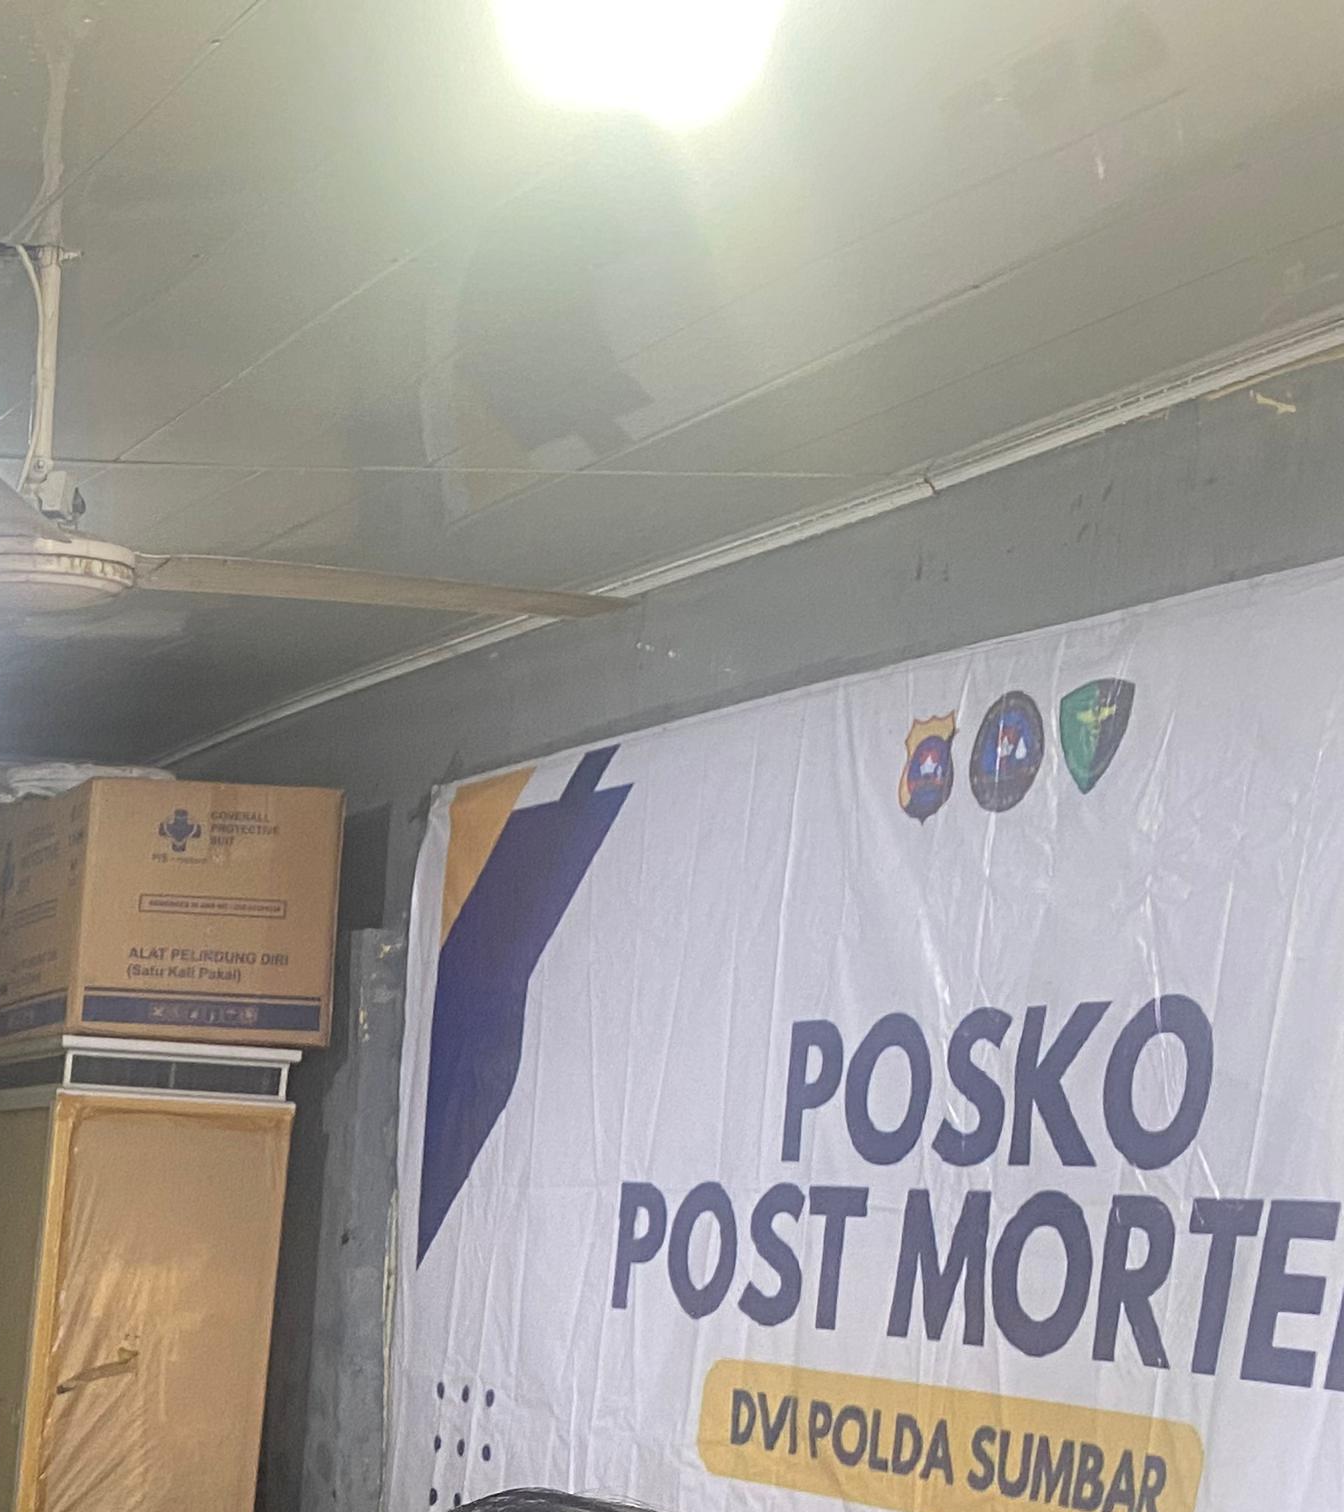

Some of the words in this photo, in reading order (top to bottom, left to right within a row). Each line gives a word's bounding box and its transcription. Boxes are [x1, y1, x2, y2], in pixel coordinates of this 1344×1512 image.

[128, 946, 167, 961] ALAT
[170, 948, 257, 965] PELINDUNG
[260, 952, 290, 967] DIRI
[781, 994, 1213, 1170] POSKO
[612, 1181, 869, 1329] POST
[887, 1187, 1344, 1391] MORTE
[730, 1388, 798, 1456] DVI
[809, 1401, 954, 1486] POLDA
